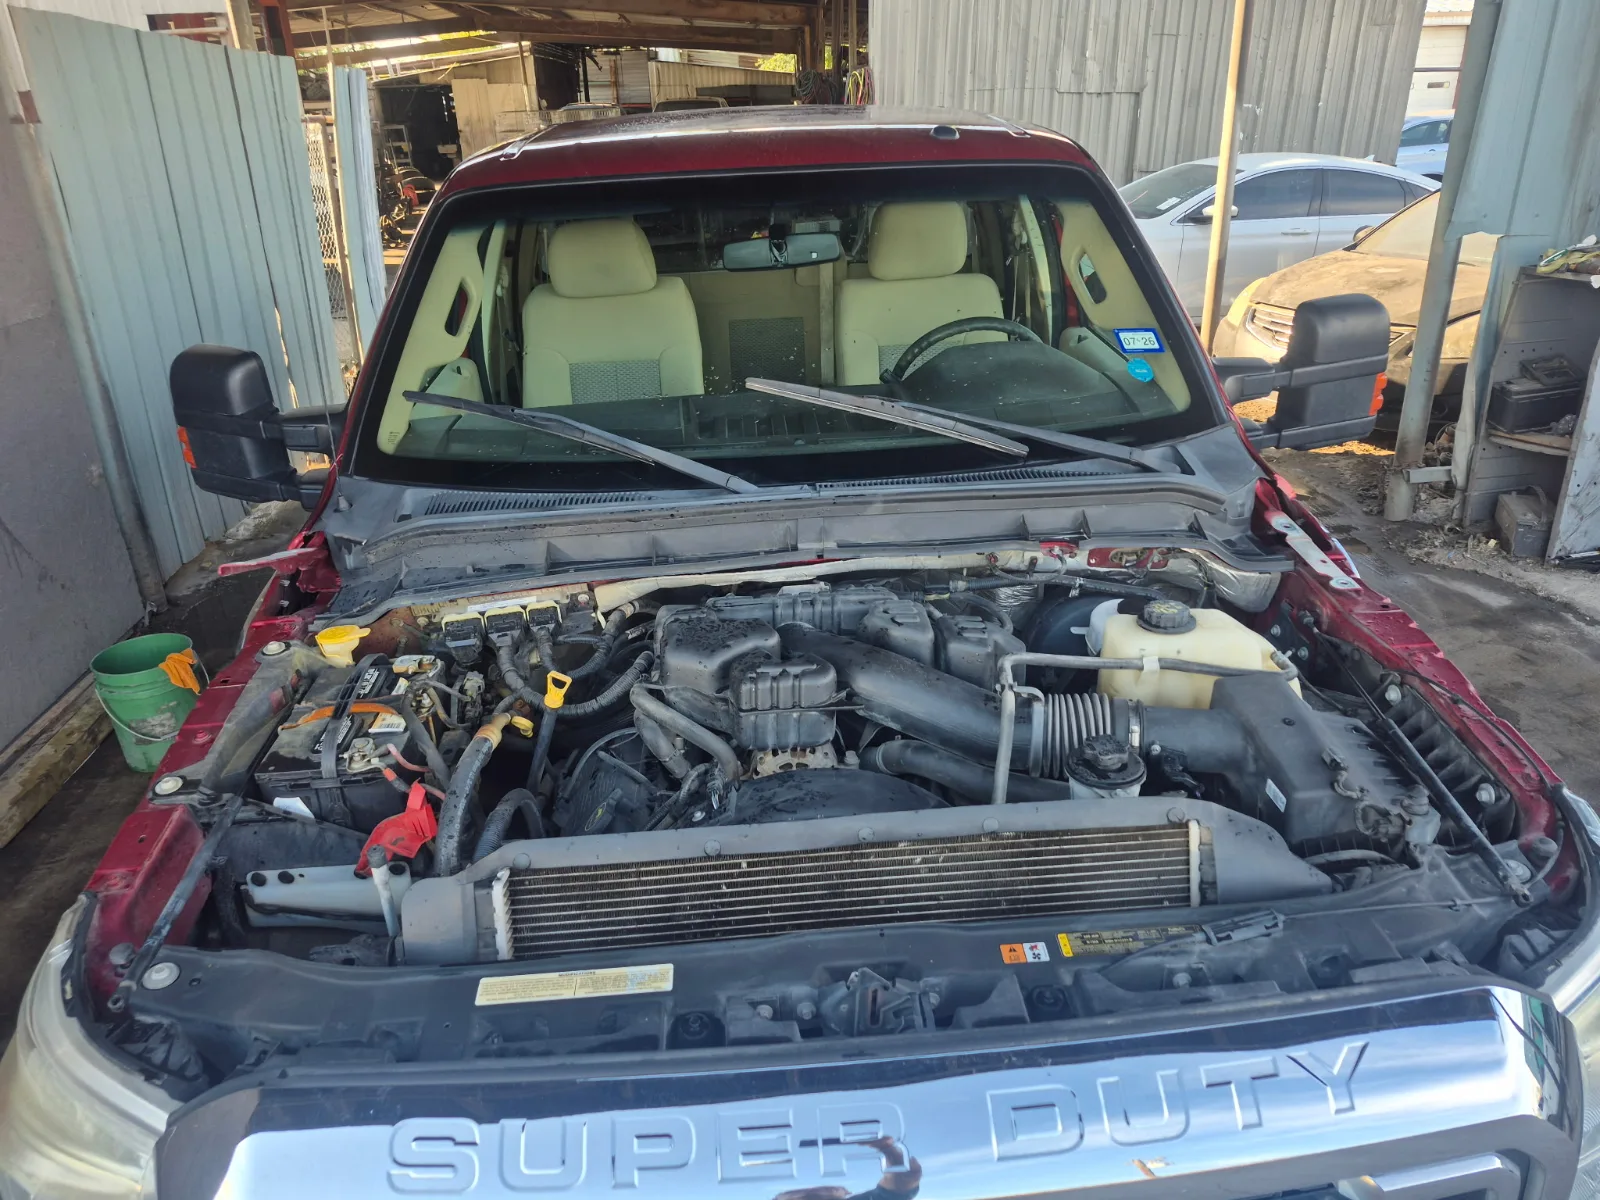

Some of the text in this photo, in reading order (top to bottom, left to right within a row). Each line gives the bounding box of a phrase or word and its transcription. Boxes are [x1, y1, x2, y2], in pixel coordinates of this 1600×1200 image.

[1123, 336, 1156, 346] 07 26
[386, 1041, 1370, 1194] SUPER DUTY
